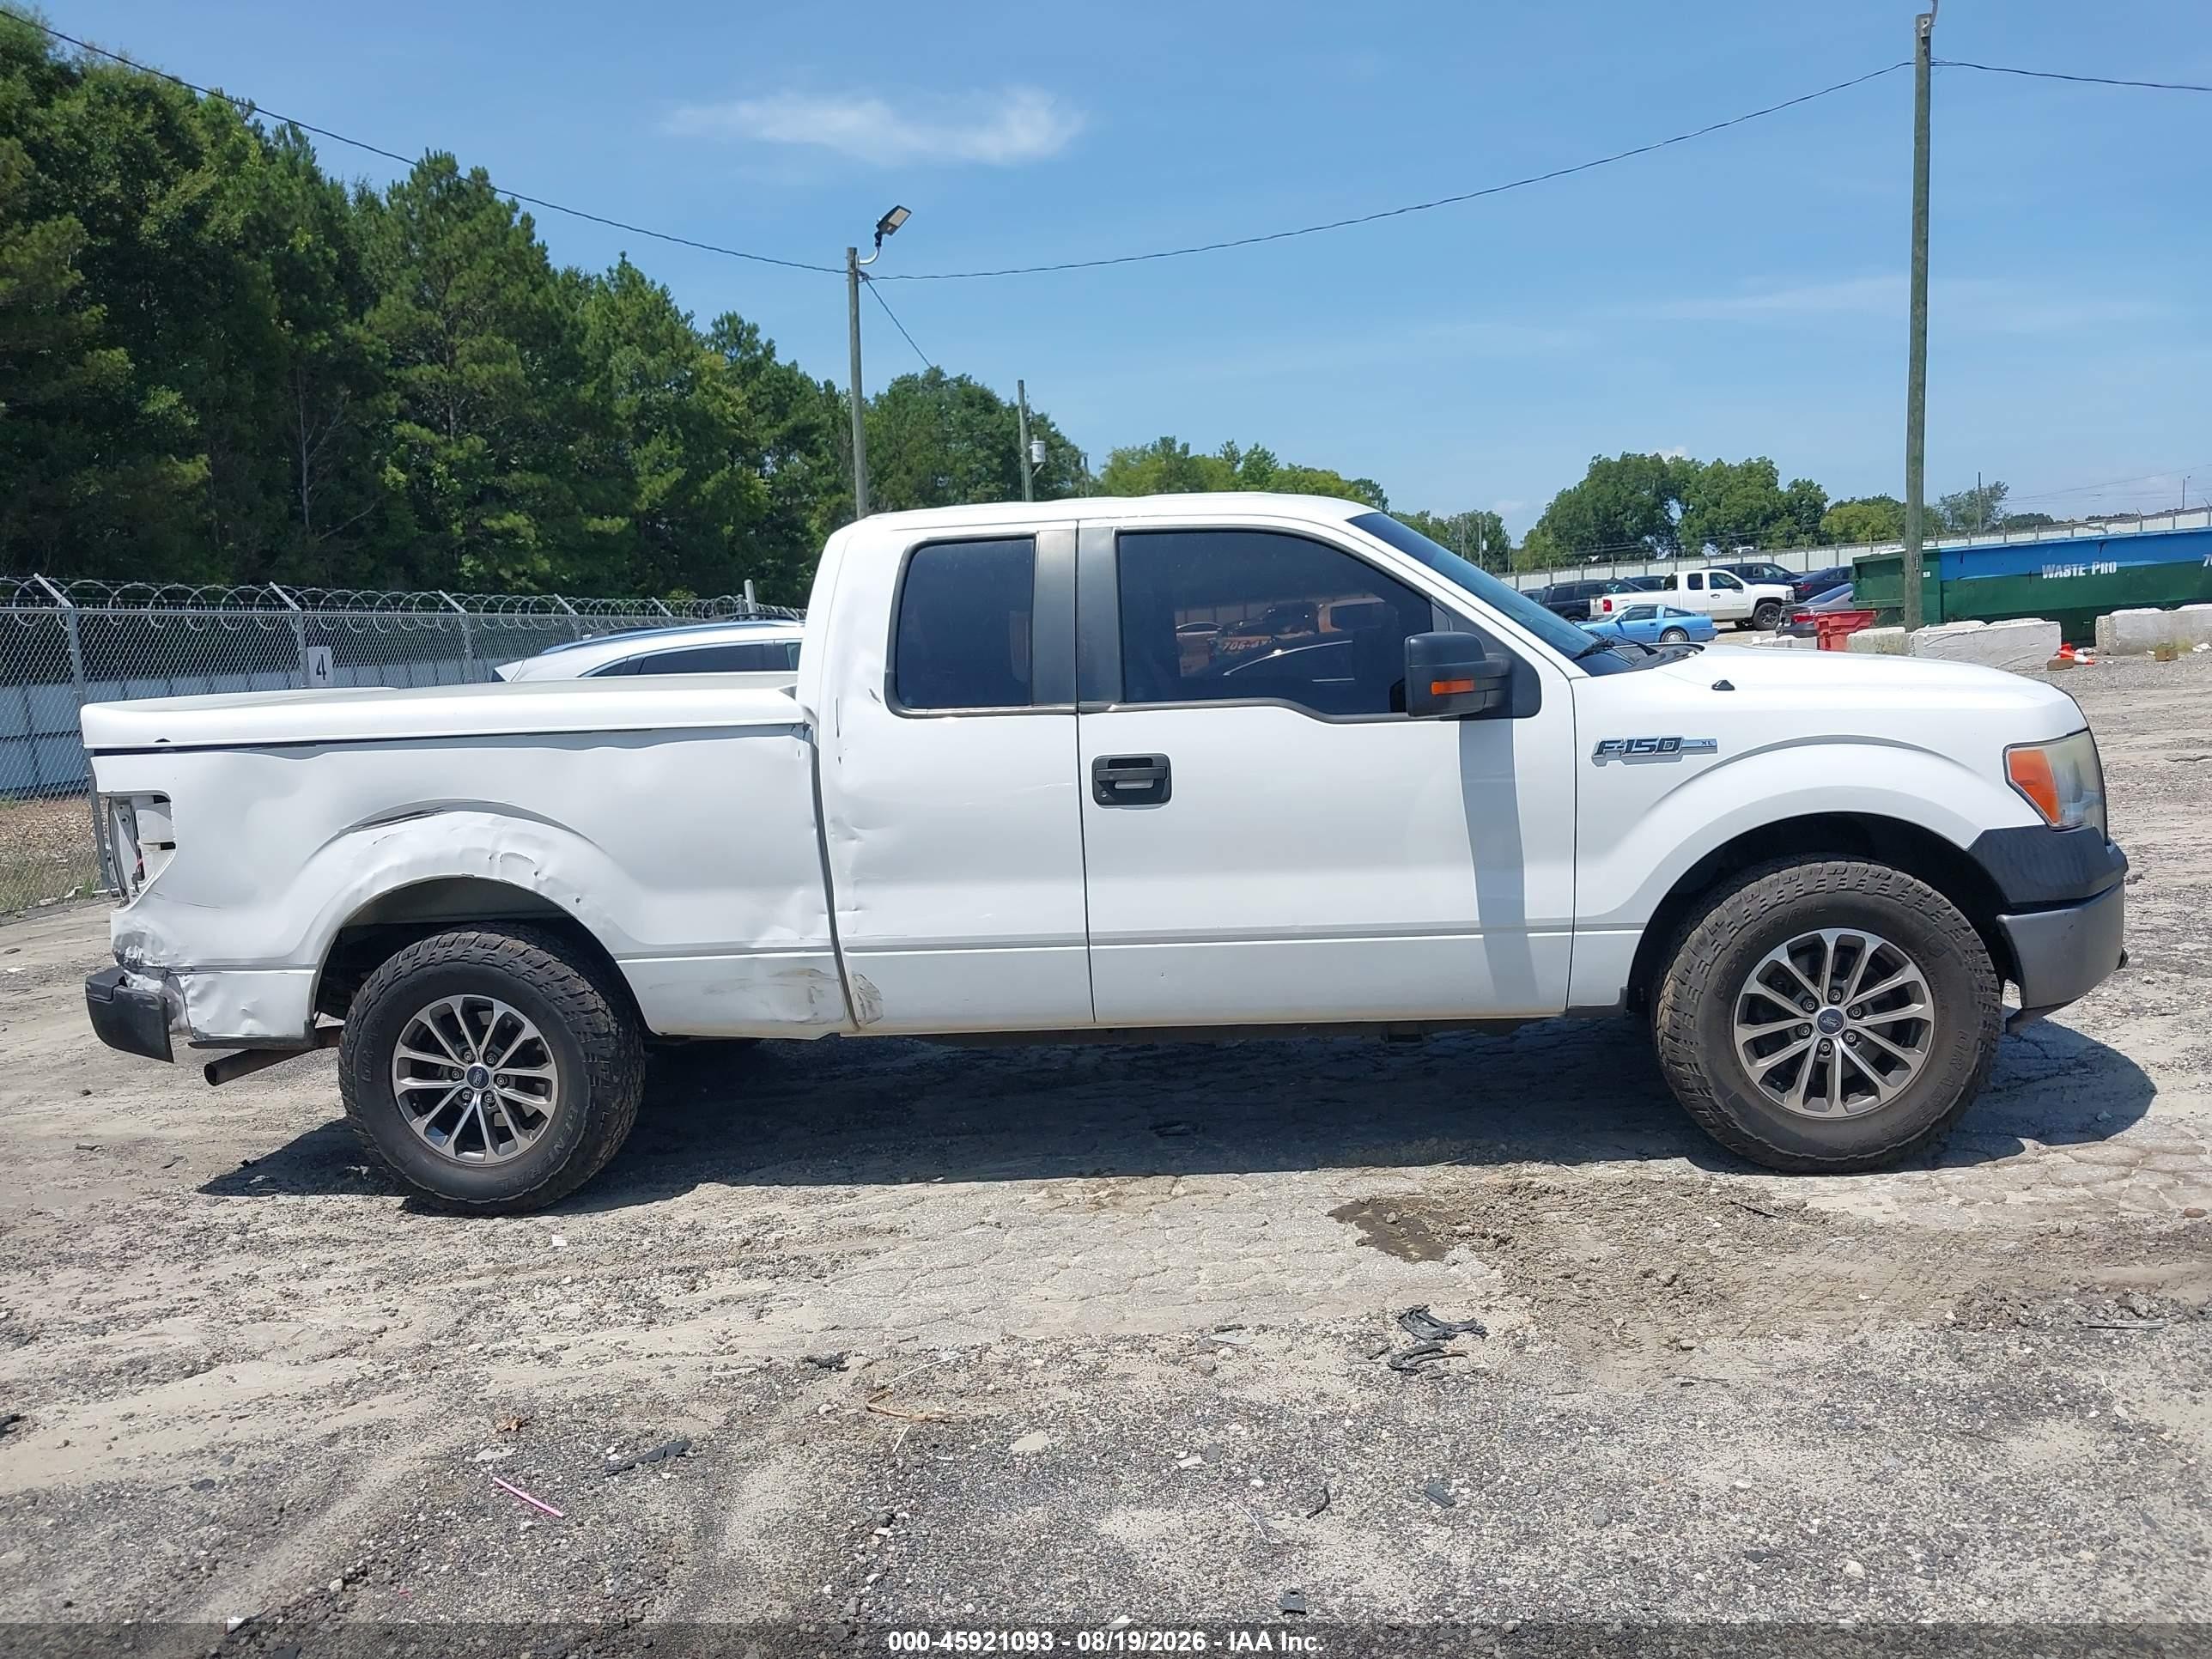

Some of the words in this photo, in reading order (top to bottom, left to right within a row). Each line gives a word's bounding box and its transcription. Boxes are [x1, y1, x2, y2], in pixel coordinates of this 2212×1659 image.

[2041, 563, 2087, 580] WASTE
[2091, 561, 2118, 575] PRO
[315, 653, 326, 681] 4
[1594, 737, 1683, 757] F-150
